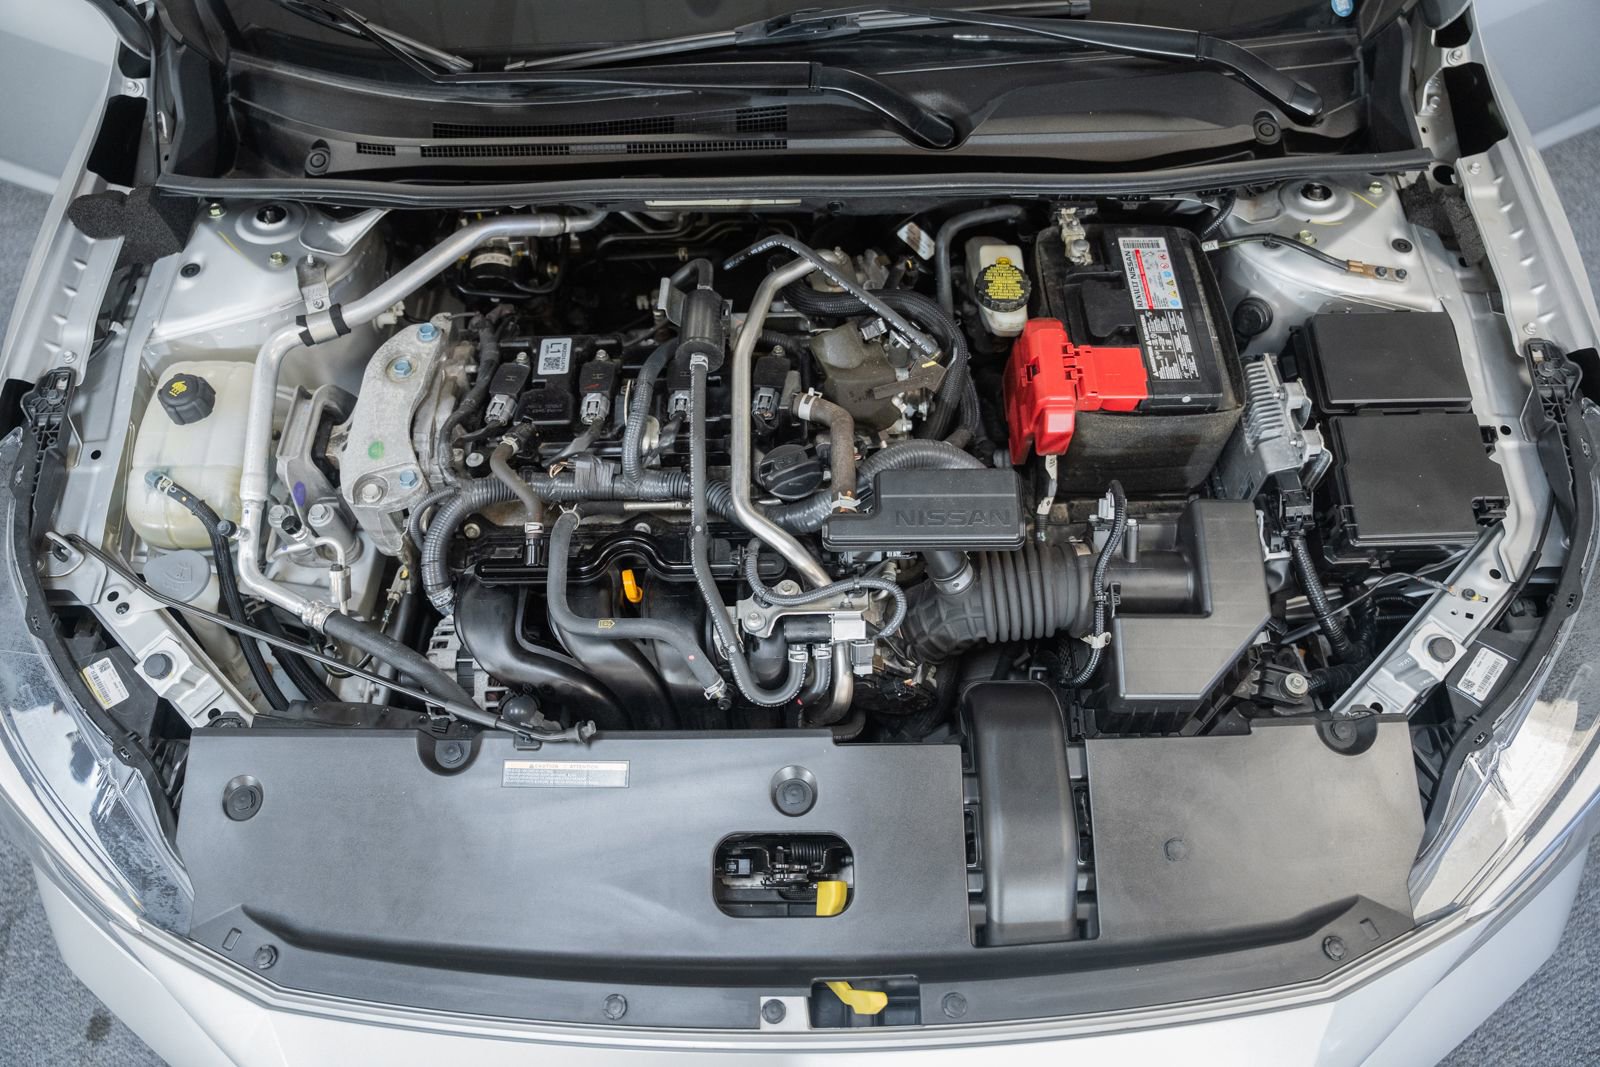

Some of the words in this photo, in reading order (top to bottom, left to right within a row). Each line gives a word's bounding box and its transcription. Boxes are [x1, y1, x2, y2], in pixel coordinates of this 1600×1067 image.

[1124, 250, 1136, 279] NISSAN
[1132, 281, 1143, 307] RENAULT
[550, 342, 562, 353] L1
[895, 512, 1011, 528] NISSAN
